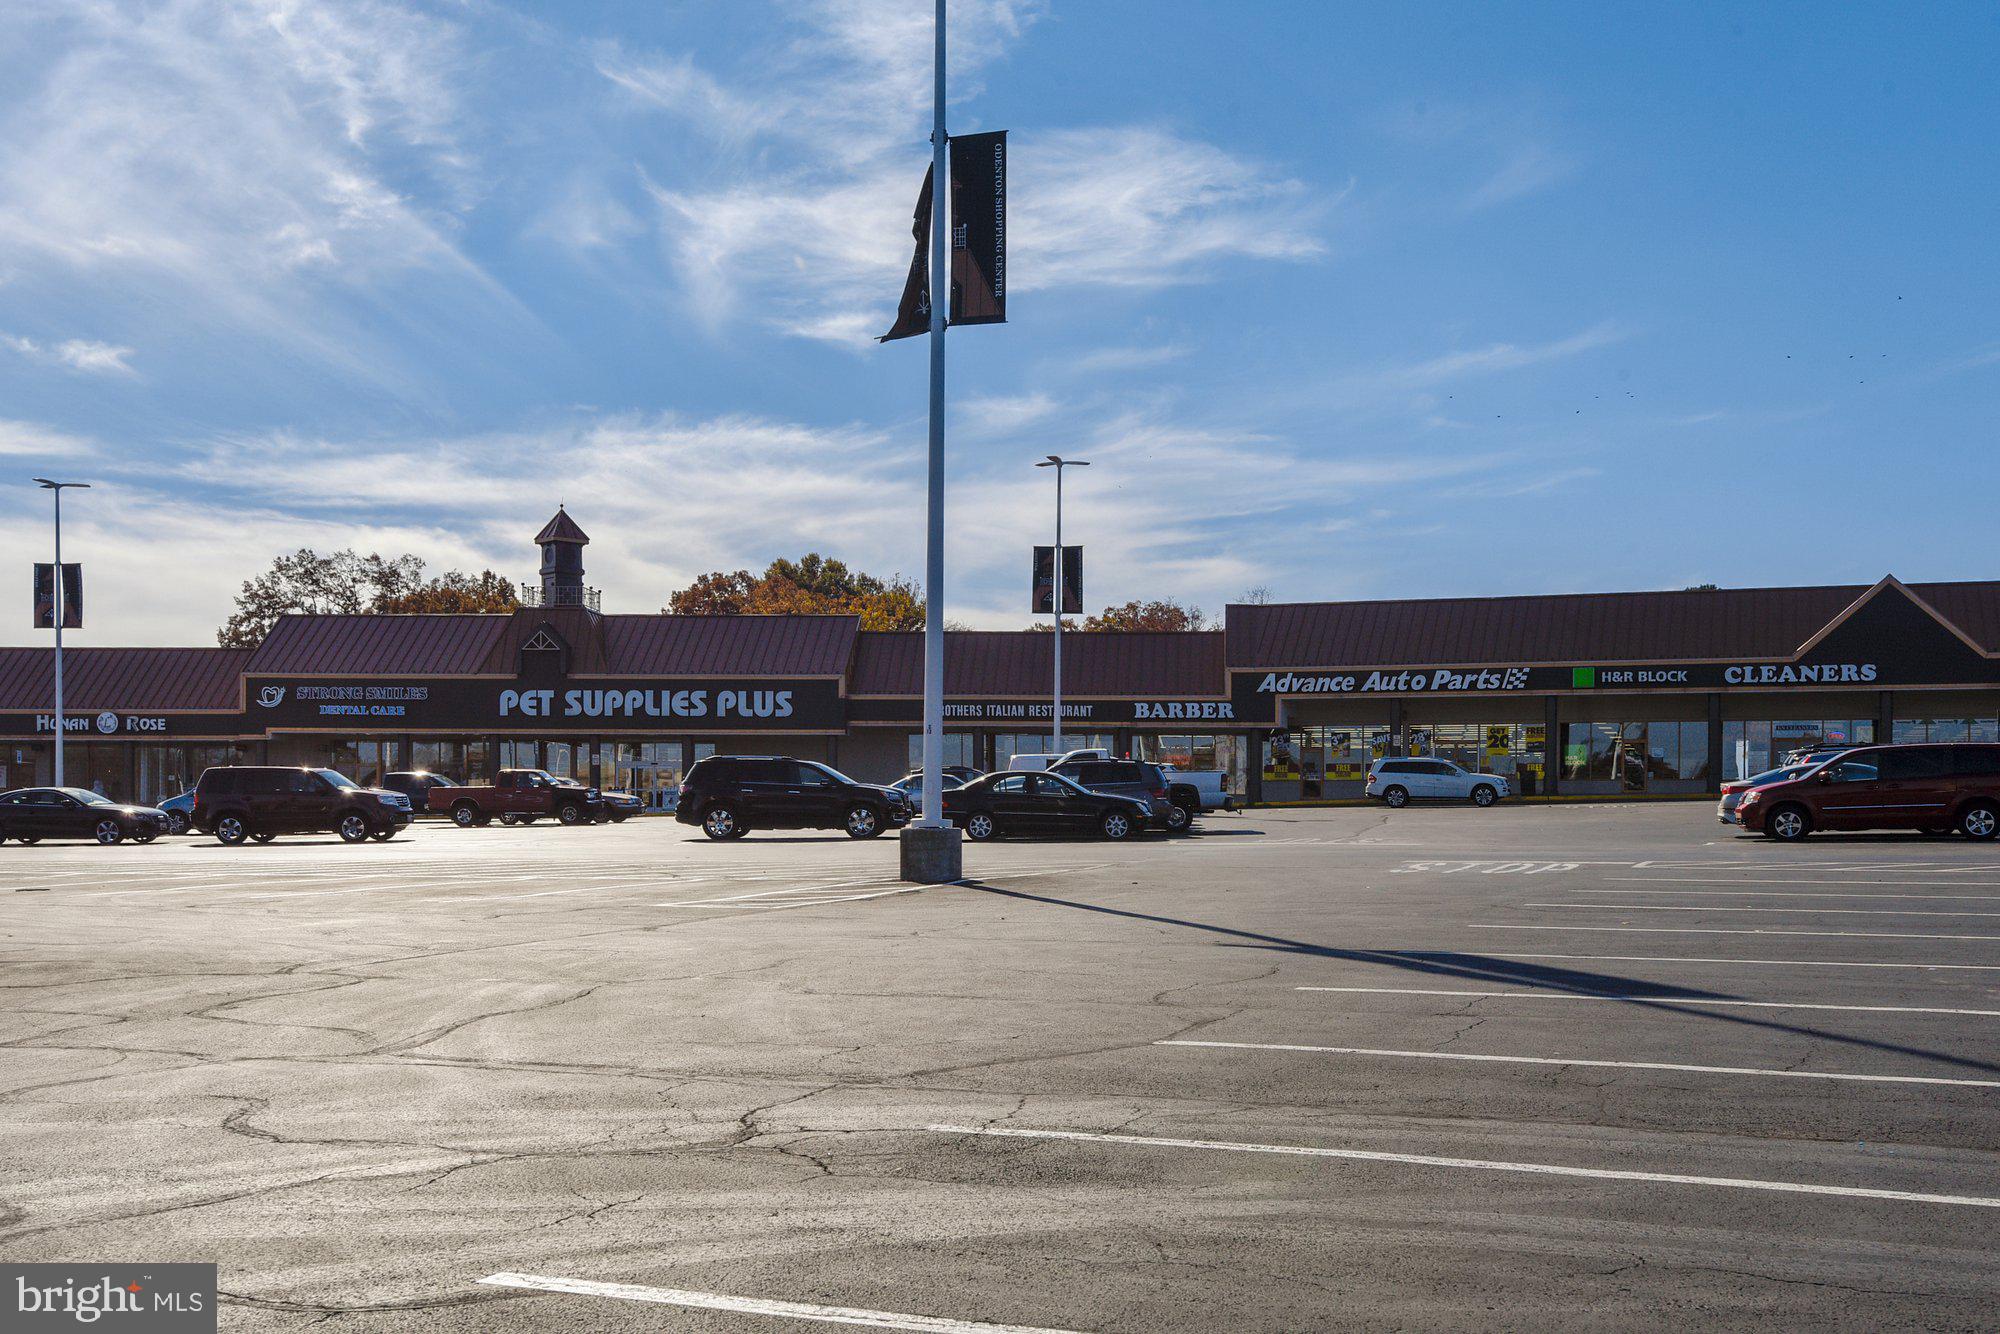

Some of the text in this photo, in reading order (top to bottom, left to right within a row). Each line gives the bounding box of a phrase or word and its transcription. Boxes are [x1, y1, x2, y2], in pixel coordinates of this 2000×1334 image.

[994, 142, 1004, 298] ODENTON SHOPPING CENTER
[1256, 668, 1501, 694] Advance Auto Parts
[1601, 670, 1688, 683] H&R BLOCK
[1724, 663, 1877, 684] CLEANERS
[296, 686, 429, 700] STRONG SMILES
[319, 704, 406, 716] DENTAL CARE
[499, 689, 793, 718] PET SUPPLIES PLUS
[986, 704, 1025, 717] ITALIAN
[1028, 704, 1093, 717] RESTURANT
[1134, 702, 1235, 719] BARBER
[126, 715, 167, 731] ROSE
[1389, 862, 1581, 875] STOP
